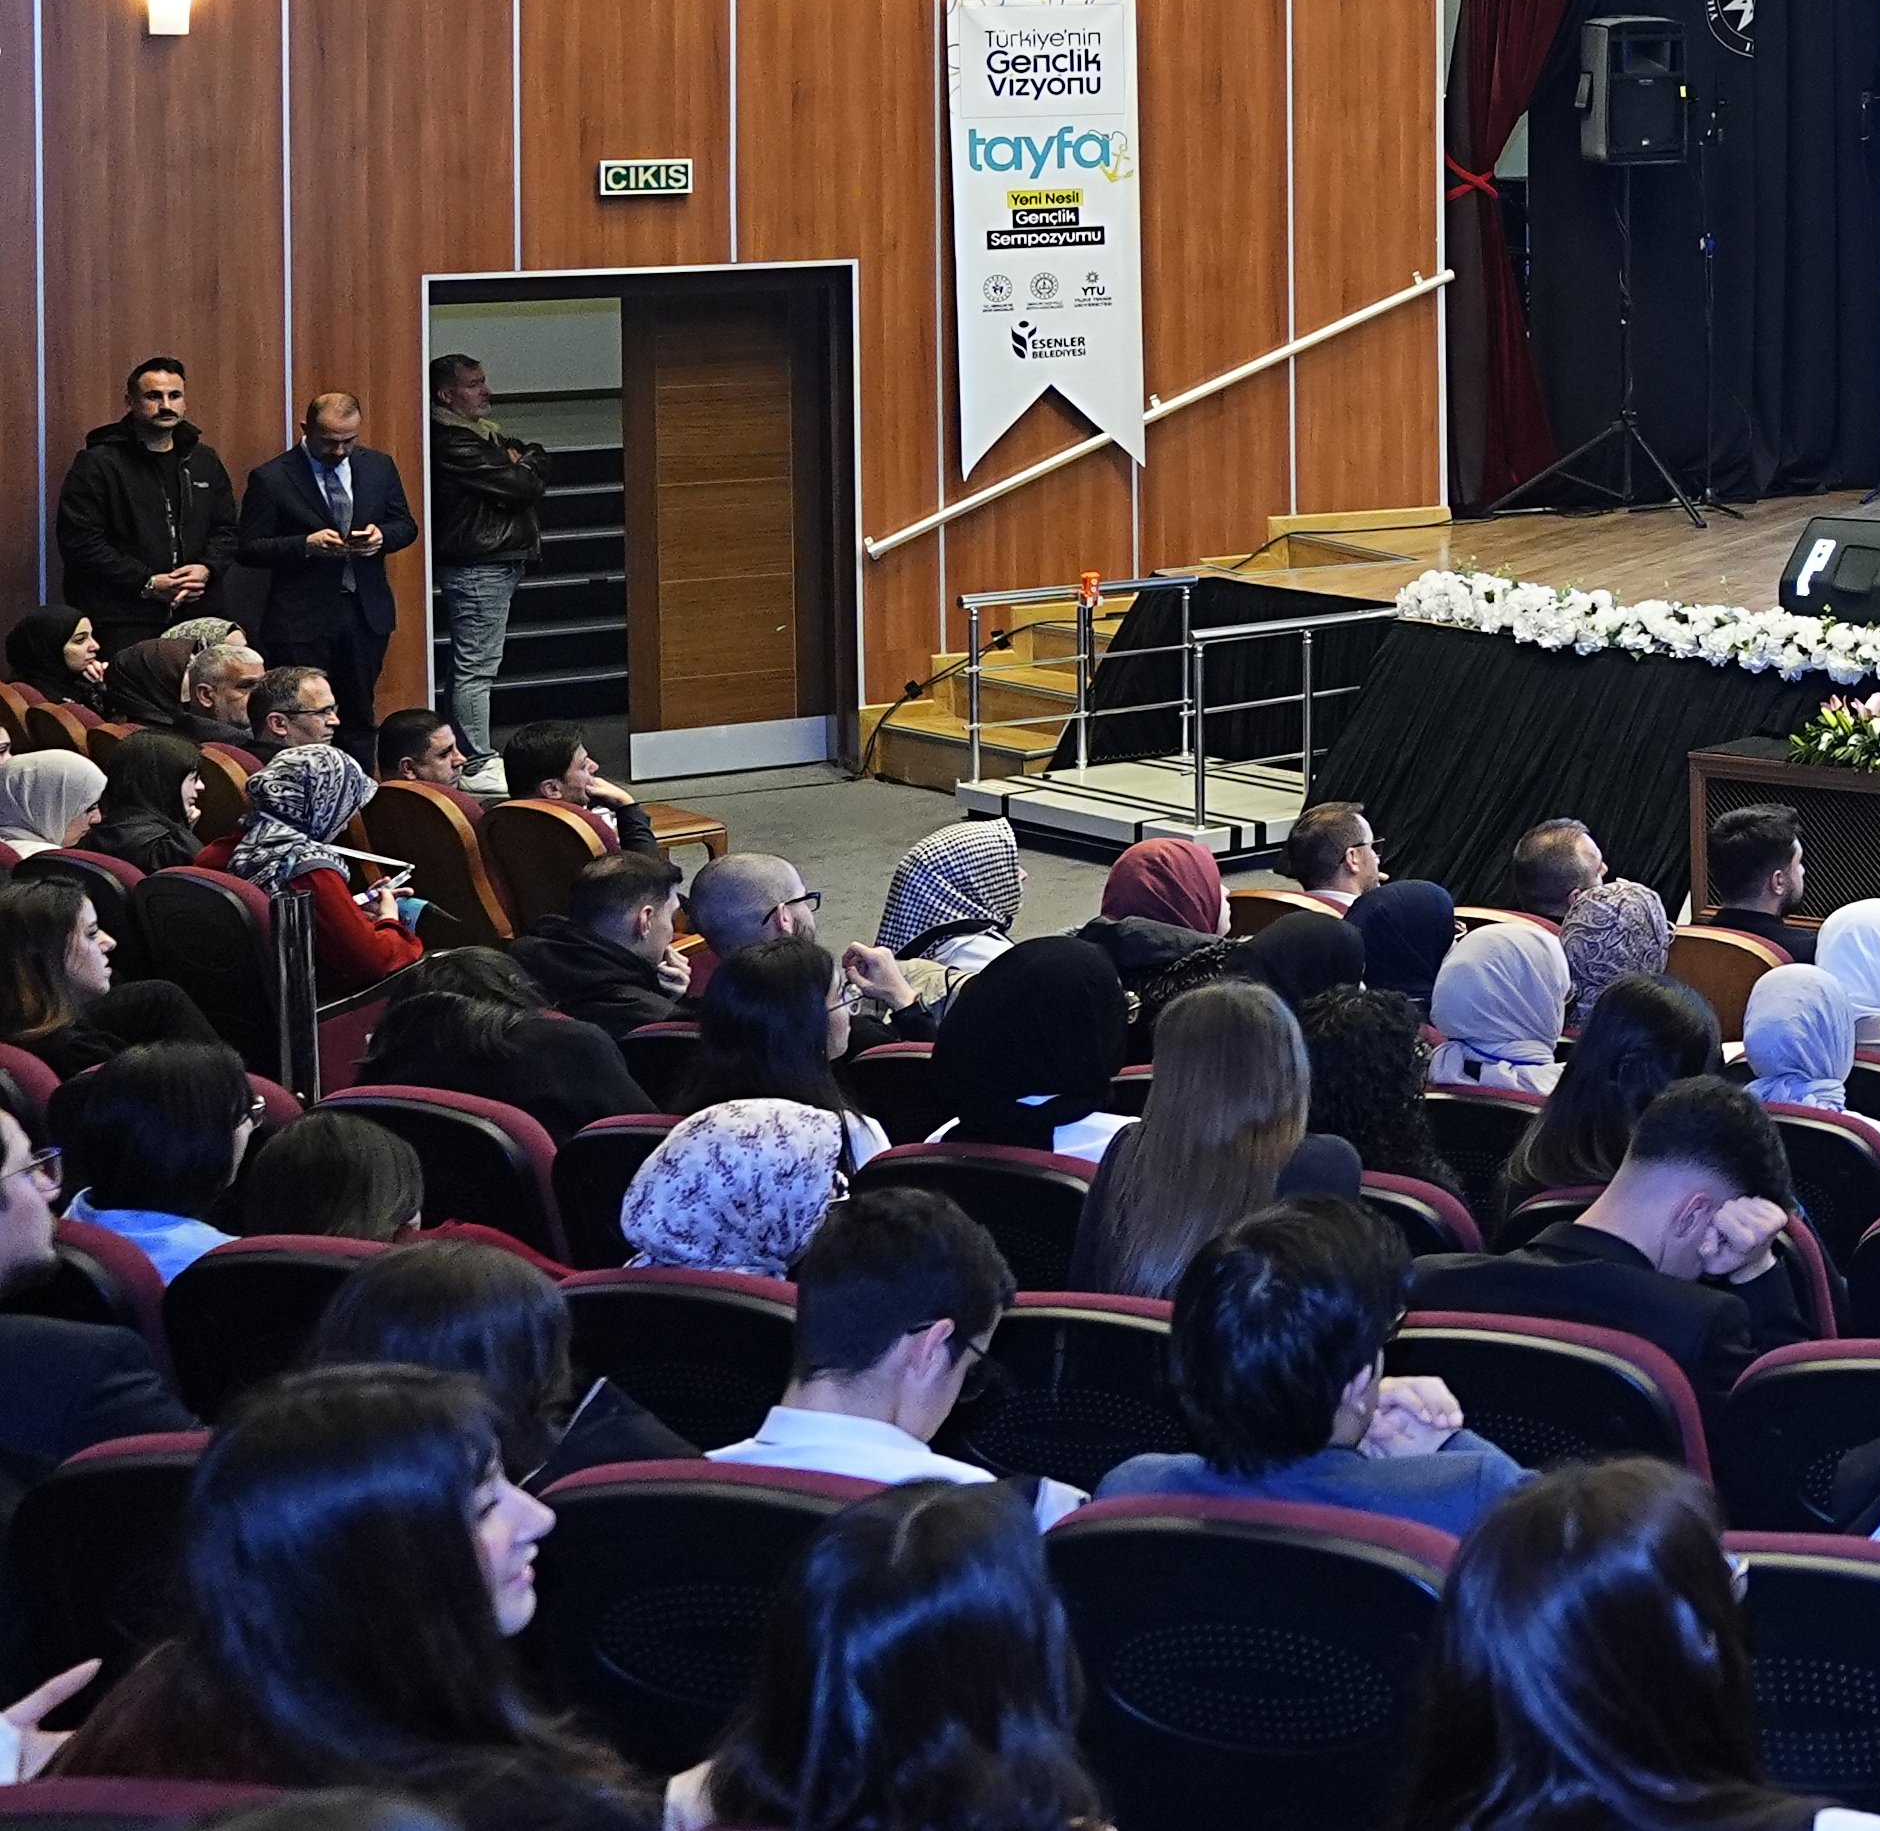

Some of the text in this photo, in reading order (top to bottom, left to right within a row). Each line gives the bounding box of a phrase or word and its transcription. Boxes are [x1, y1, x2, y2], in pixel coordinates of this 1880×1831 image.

[985, 28, 1101, 51] Türkiye'nin
[987, 74, 1101, 100] Vizyonu
[969, 125, 1110, 179] tayfa
[1011, 191, 1079, 205] Yeni Nesil
[1015, 209, 1076, 226] Gençlik
[990, 230, 1102, 247] Sempozyumu
[1082, 287, 1104, 295] YTU
[1032, 336, 1086, 349] ESENLER
